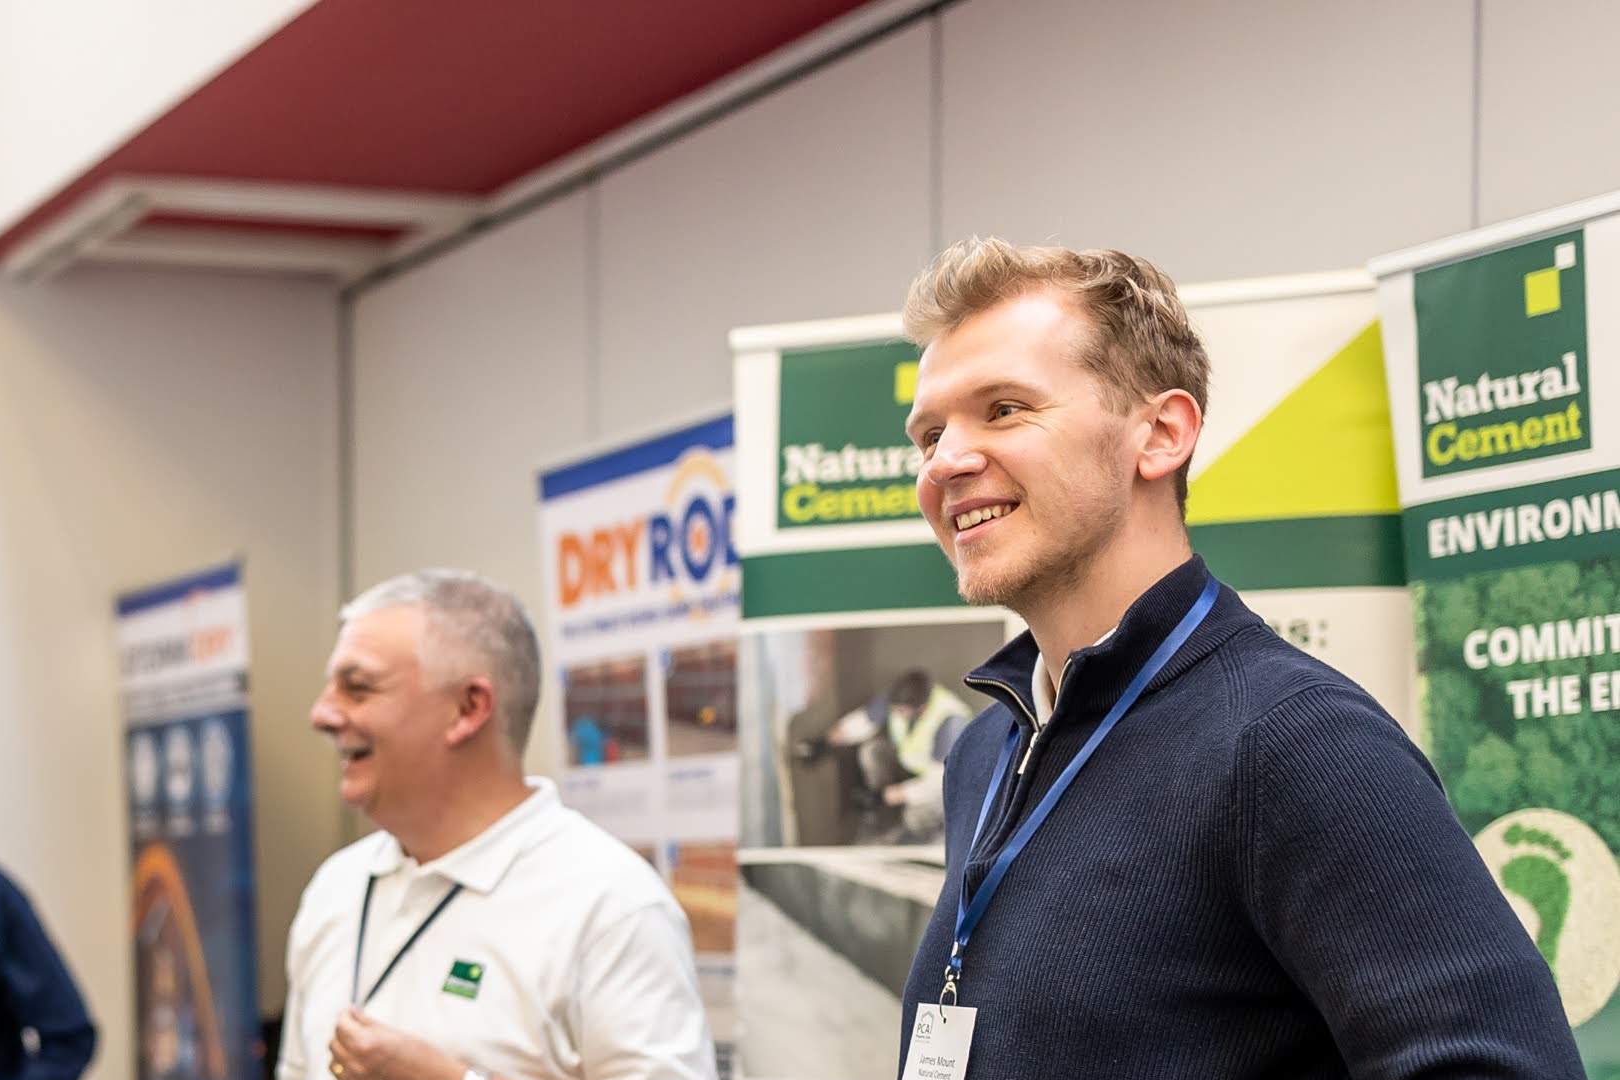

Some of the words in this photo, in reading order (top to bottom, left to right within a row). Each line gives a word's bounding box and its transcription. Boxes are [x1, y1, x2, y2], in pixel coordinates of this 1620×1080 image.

[1423, 351, 1581, 424] Natural
[1426, 401, 1582, 466] Cement
[783, 443, 924, 484] Natura
[1506, 675, 1583, 720] THE
